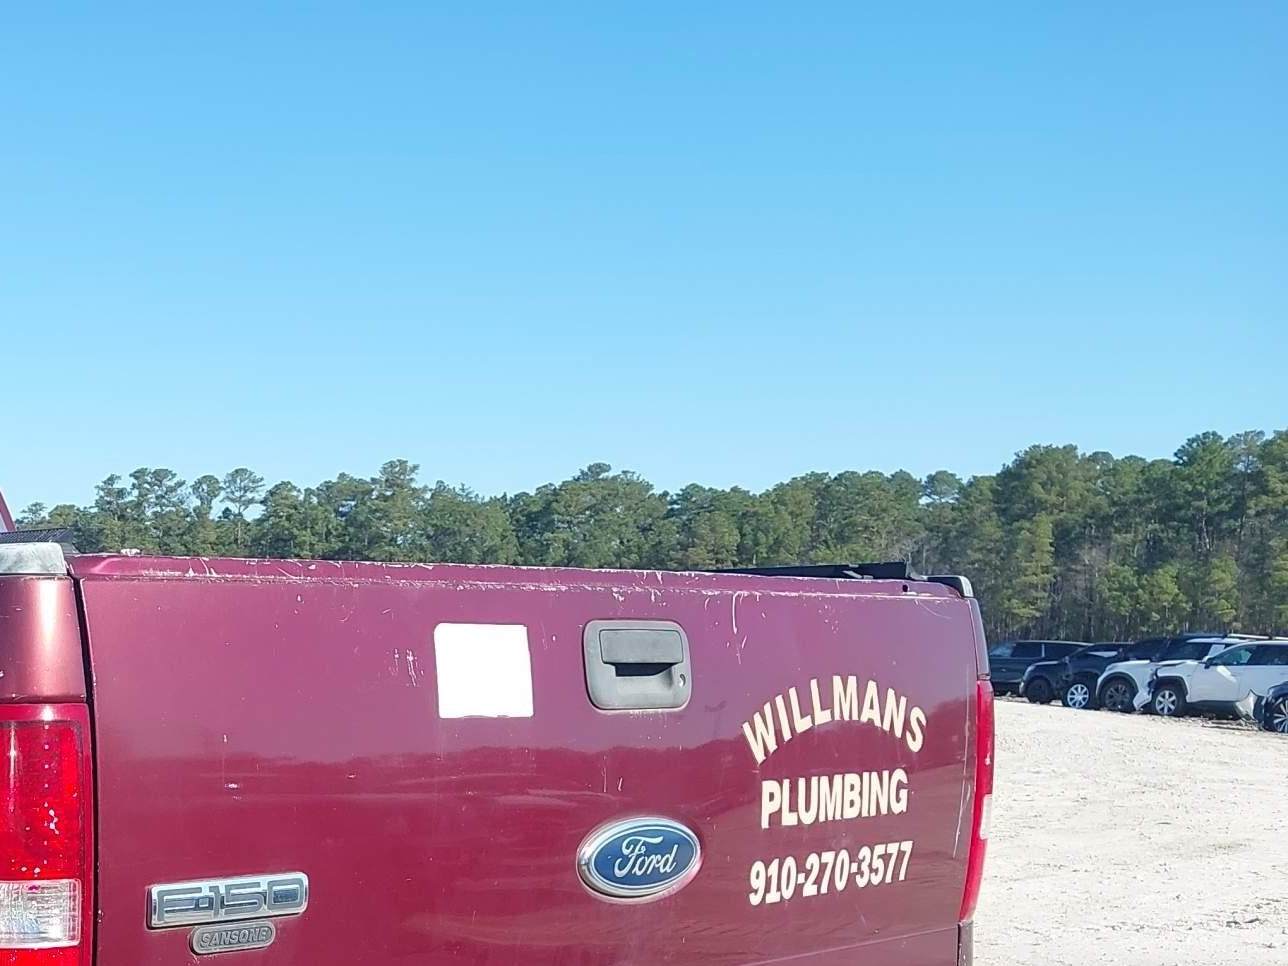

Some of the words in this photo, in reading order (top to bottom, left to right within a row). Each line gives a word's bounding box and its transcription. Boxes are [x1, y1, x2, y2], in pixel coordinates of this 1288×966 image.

[743, 675, 927, 766] WILLMANS
[761, 768, 908, 829] PLUMBING
[614, 836, 678, 877] Ford
[748, 840, 914, 906] 910-270-3577
[157, 877, 305, 922] F-150
[199, 927, 269, 948] SANSONE
